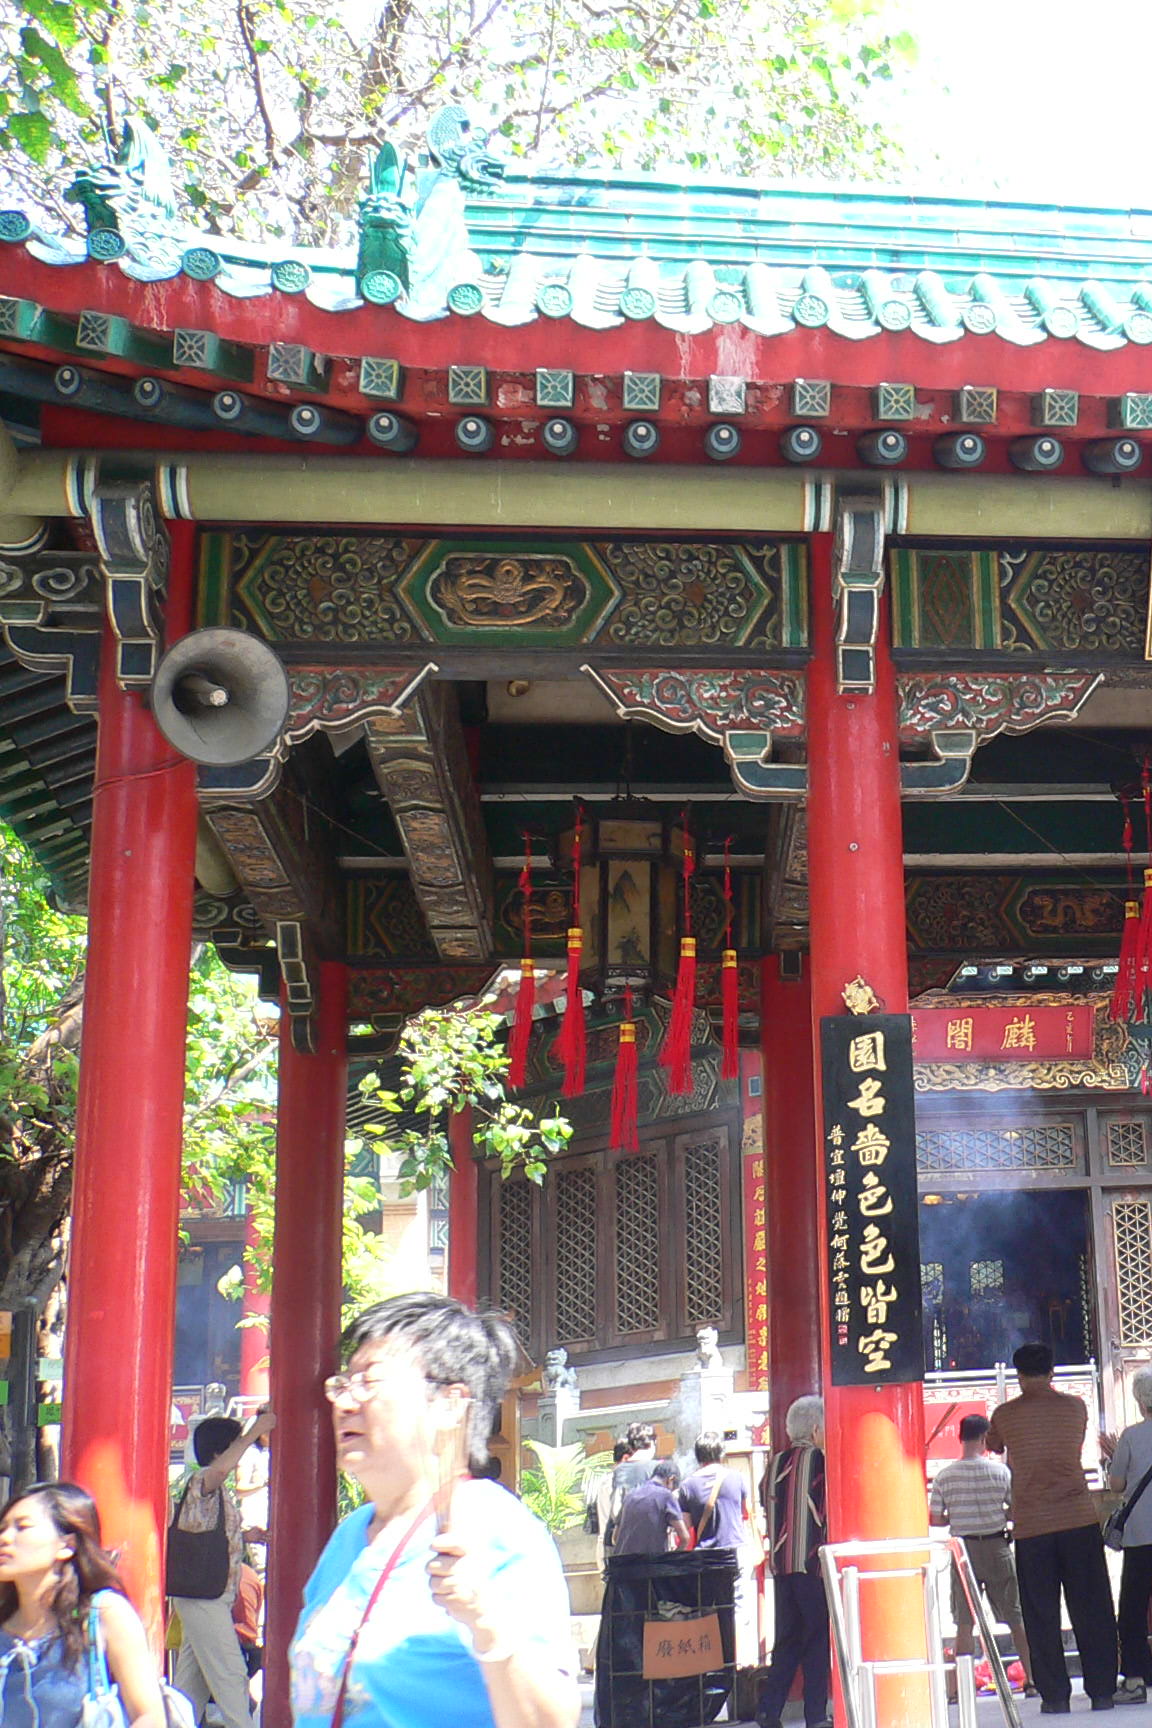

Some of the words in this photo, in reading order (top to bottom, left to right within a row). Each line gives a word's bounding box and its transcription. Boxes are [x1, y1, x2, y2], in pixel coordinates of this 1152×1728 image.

[847, 1030, 898, 1372] 園名嗇色色皆空
